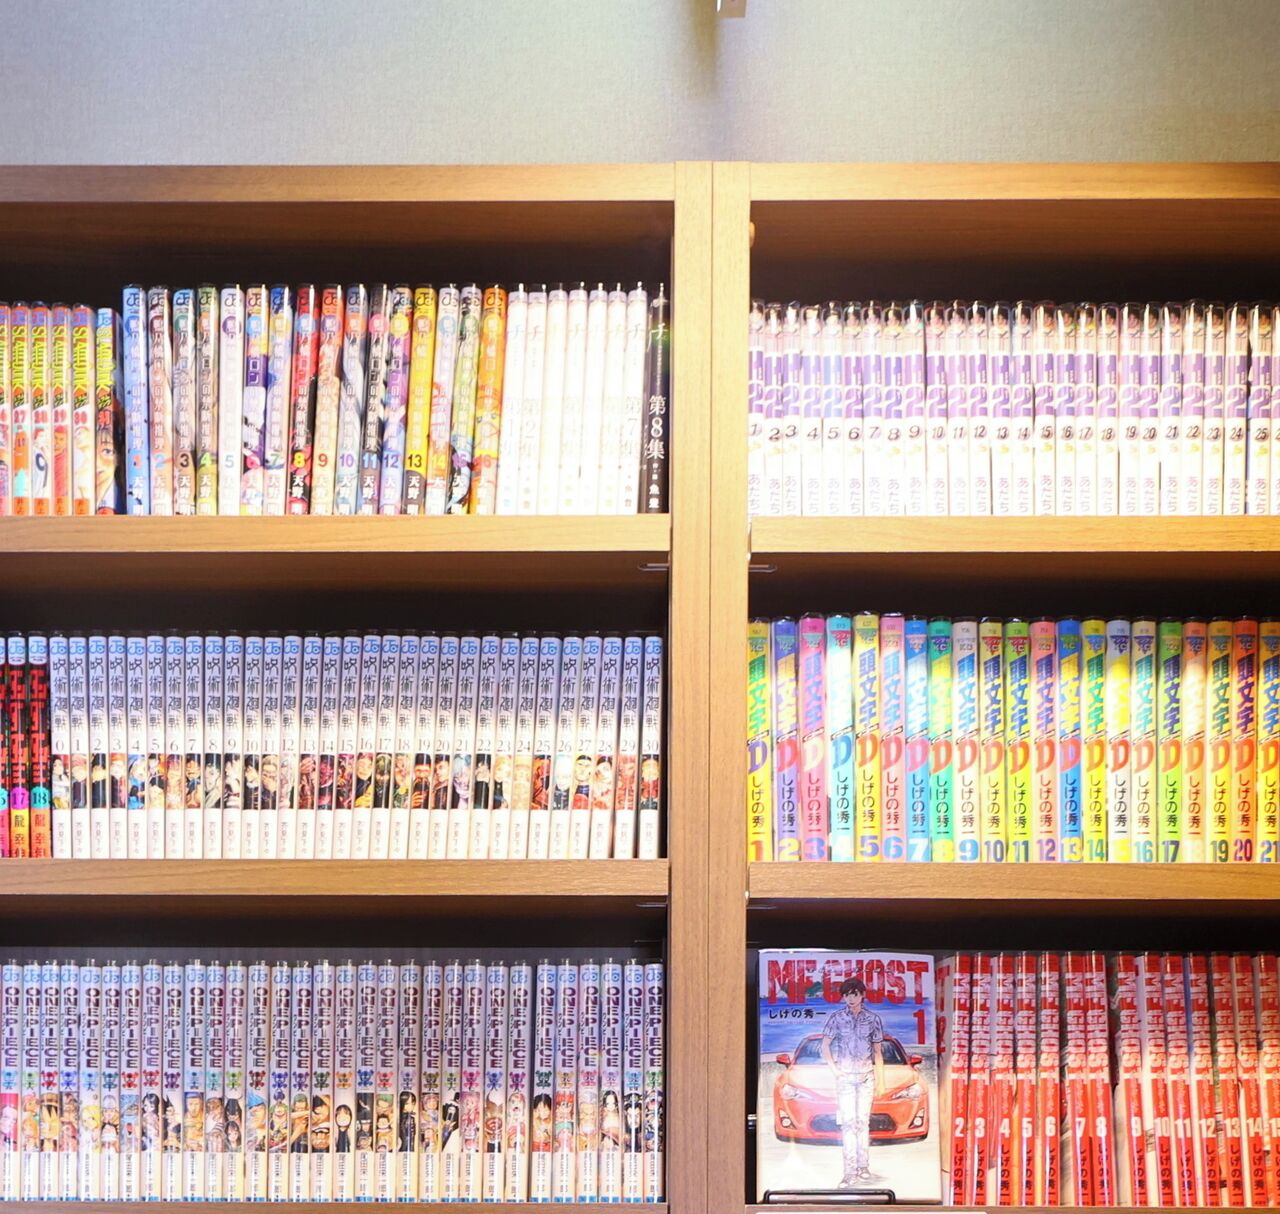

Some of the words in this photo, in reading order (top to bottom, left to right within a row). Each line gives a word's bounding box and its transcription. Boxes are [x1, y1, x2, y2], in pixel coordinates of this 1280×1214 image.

[647, 396, 666, 459] 第8集
[769, 428, 780, 441] 2
[848, 427, 860, 439] 6
[909, 426, 920, 438] 9
[180, 454, 189, 467] 3
[225, 455, 234, 468] 5
[294, 452, 303, 465] 8
[319, 454, 327, 467] 9
[340, 454, 354, 467] 10
[363, 454, 377, 467] 11
[384, 454, 398, 468] 12
[408, 454, 422, 467] 13
[56, 740, 64, 751] 0
[94, 739, 101, 751] 2
[113, 739, 121, 751] 3
[152, 739, 160, 751] 5
[644, 738, 659, 752] 30
[31, 790, 48, 806] 18
[752, 775, 764, 835] しげの秀一
[862, 770, 875, 828] しげの秀一
[961, 775, 974, 834] しげの秀一
[751, 841, 763, 860] 1
[861, 836, 879, 858] 5
[883, 837, 903, 858] 6
[959, 840, 979, 860] 9
[768, 960, 817, 1004] MF
[823, 960, 928, 1004] GHOST
[537, 988, 554, 1017] ONE
[769, 1009, 826, 1018] しげの秀一
[913, 1010, 925, 1044] 1
[539, 1021, 553, 1068] PIECE
[955, 1118, 963, 1136] 2
[976, 1118, 984, 1136] 3
[1000, 1118, 1010, 1136] 4
[1096, 1117, 1106, 1136] 8
[1155, 1118, 1169, 1136] 10
[1200, 1118, 1216, 1136] 12
